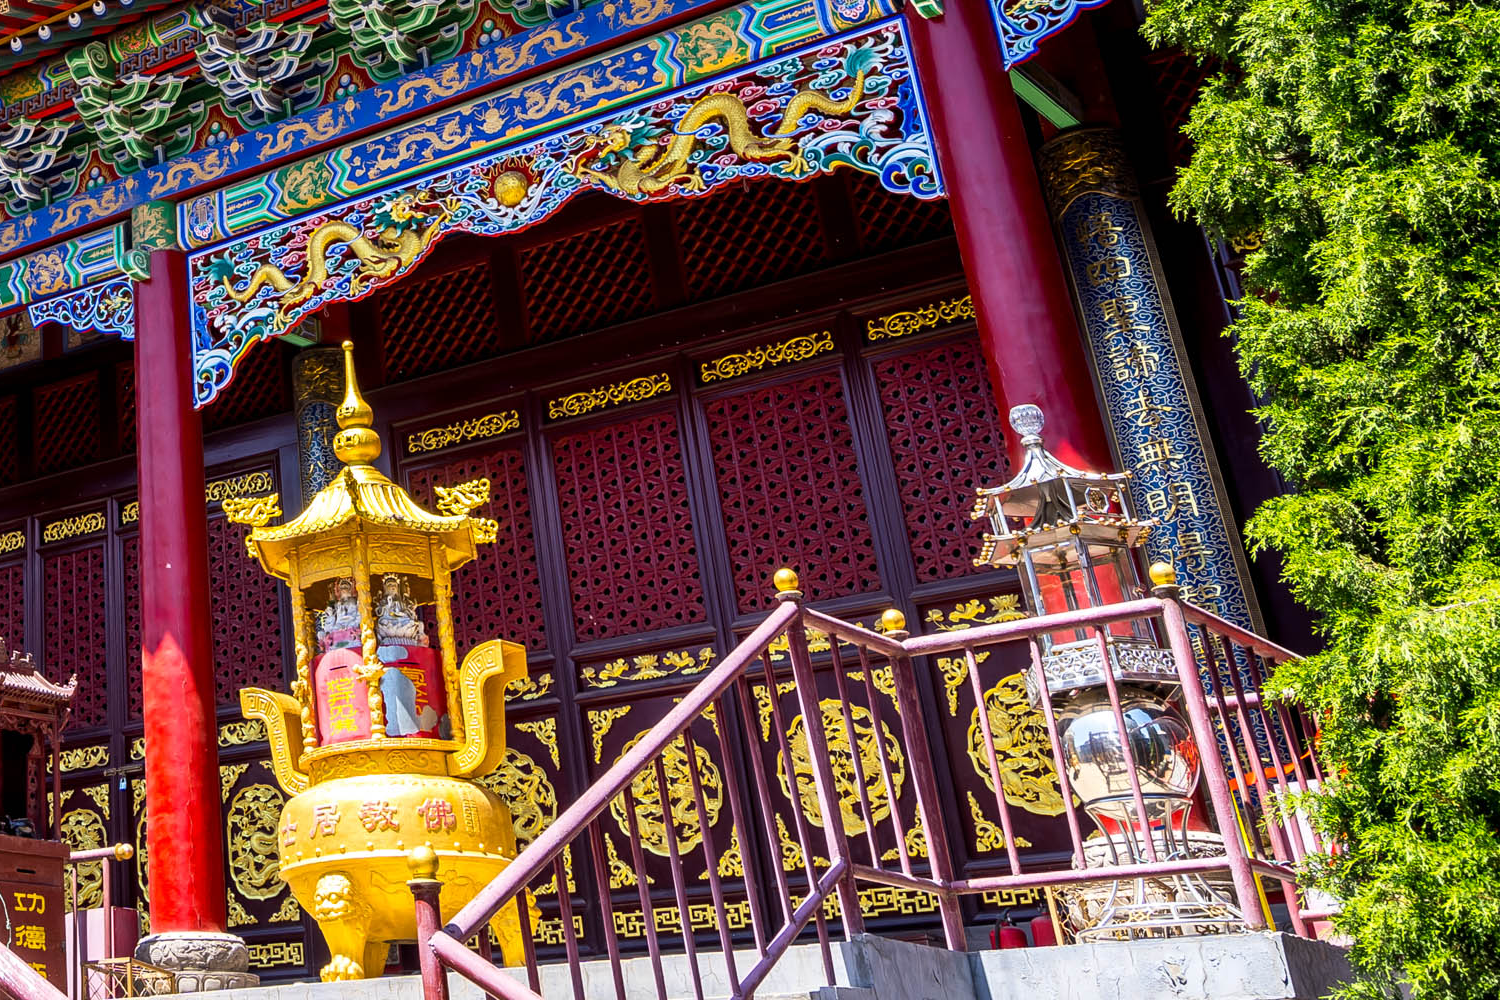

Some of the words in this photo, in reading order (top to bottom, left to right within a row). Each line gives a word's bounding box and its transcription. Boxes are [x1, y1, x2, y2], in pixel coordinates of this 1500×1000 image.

[1077, 212, 1238, 676] 悟四聖諦去無明得智
